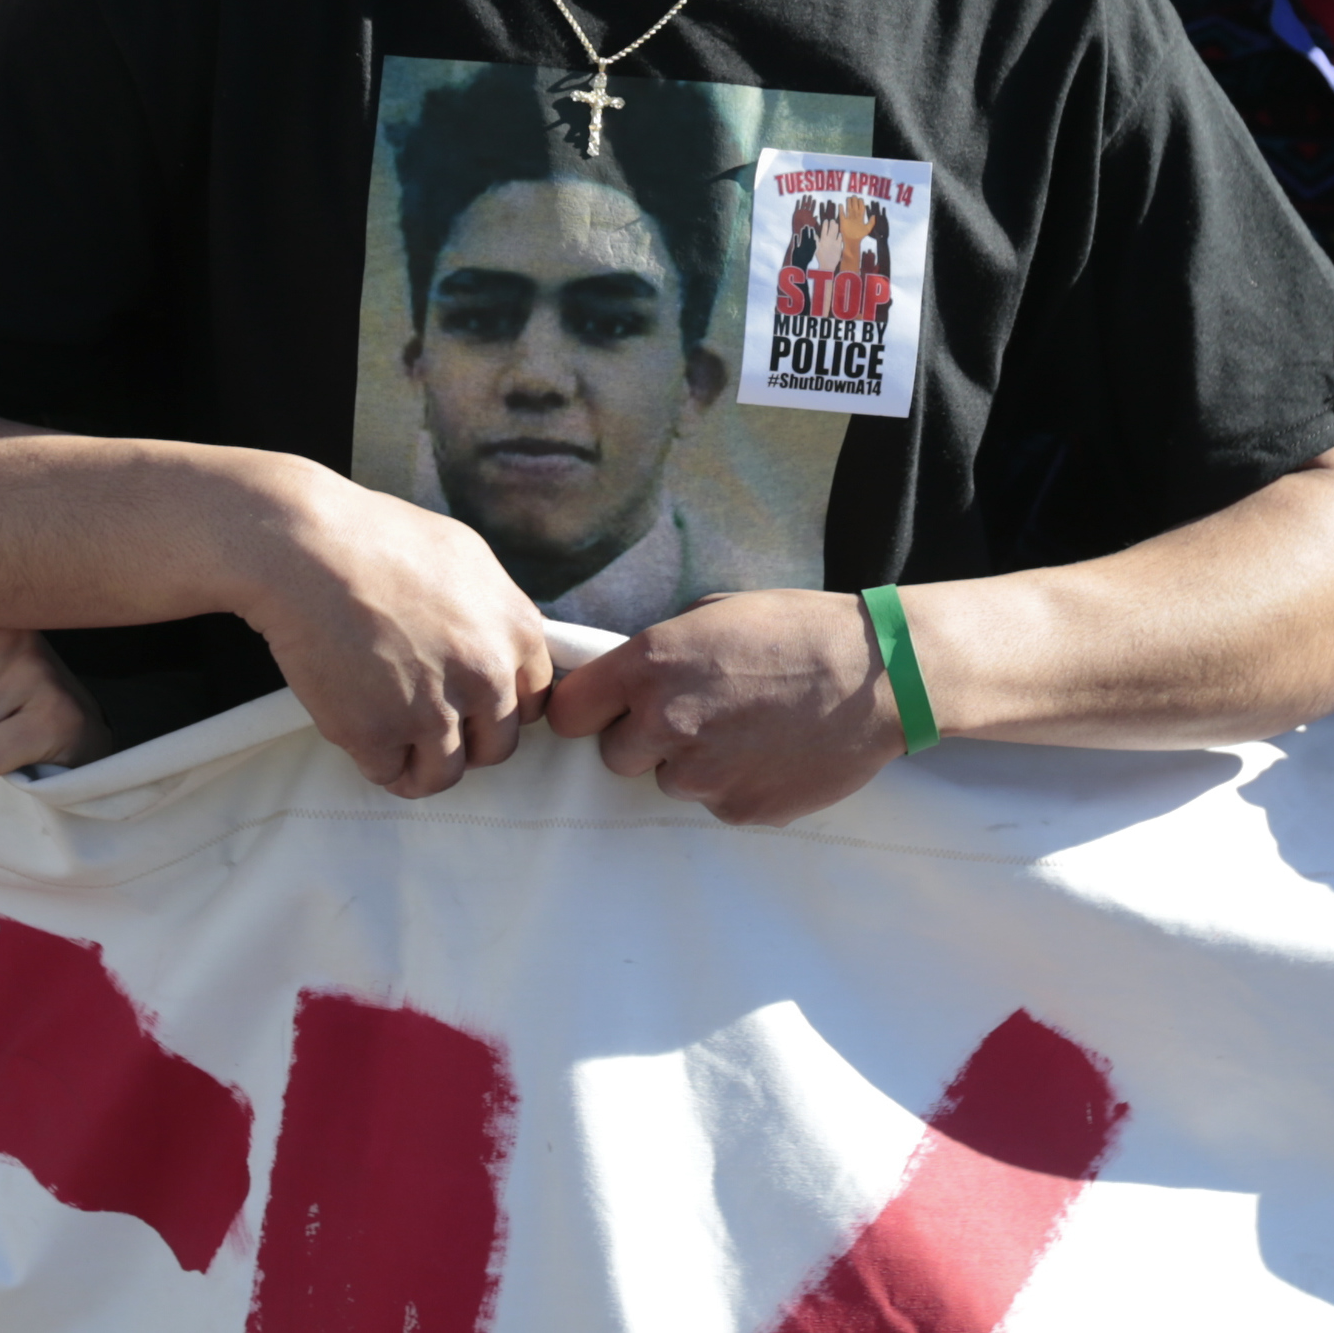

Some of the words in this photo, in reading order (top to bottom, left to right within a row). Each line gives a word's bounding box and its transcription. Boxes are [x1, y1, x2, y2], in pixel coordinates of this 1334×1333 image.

[774, 169, 845, 197] TUESDAY
[847, 171, 892, 201] APRIL
[896, 182, 914, 207] 14
[776, 266, 891, 322] STOP
[773, 314, 856, 342] MURDER
[862, 321, 887, 344] BY
[769, 336, 886, 380] POLICE
[767, 373, 882, 397] #ShutDownA14
